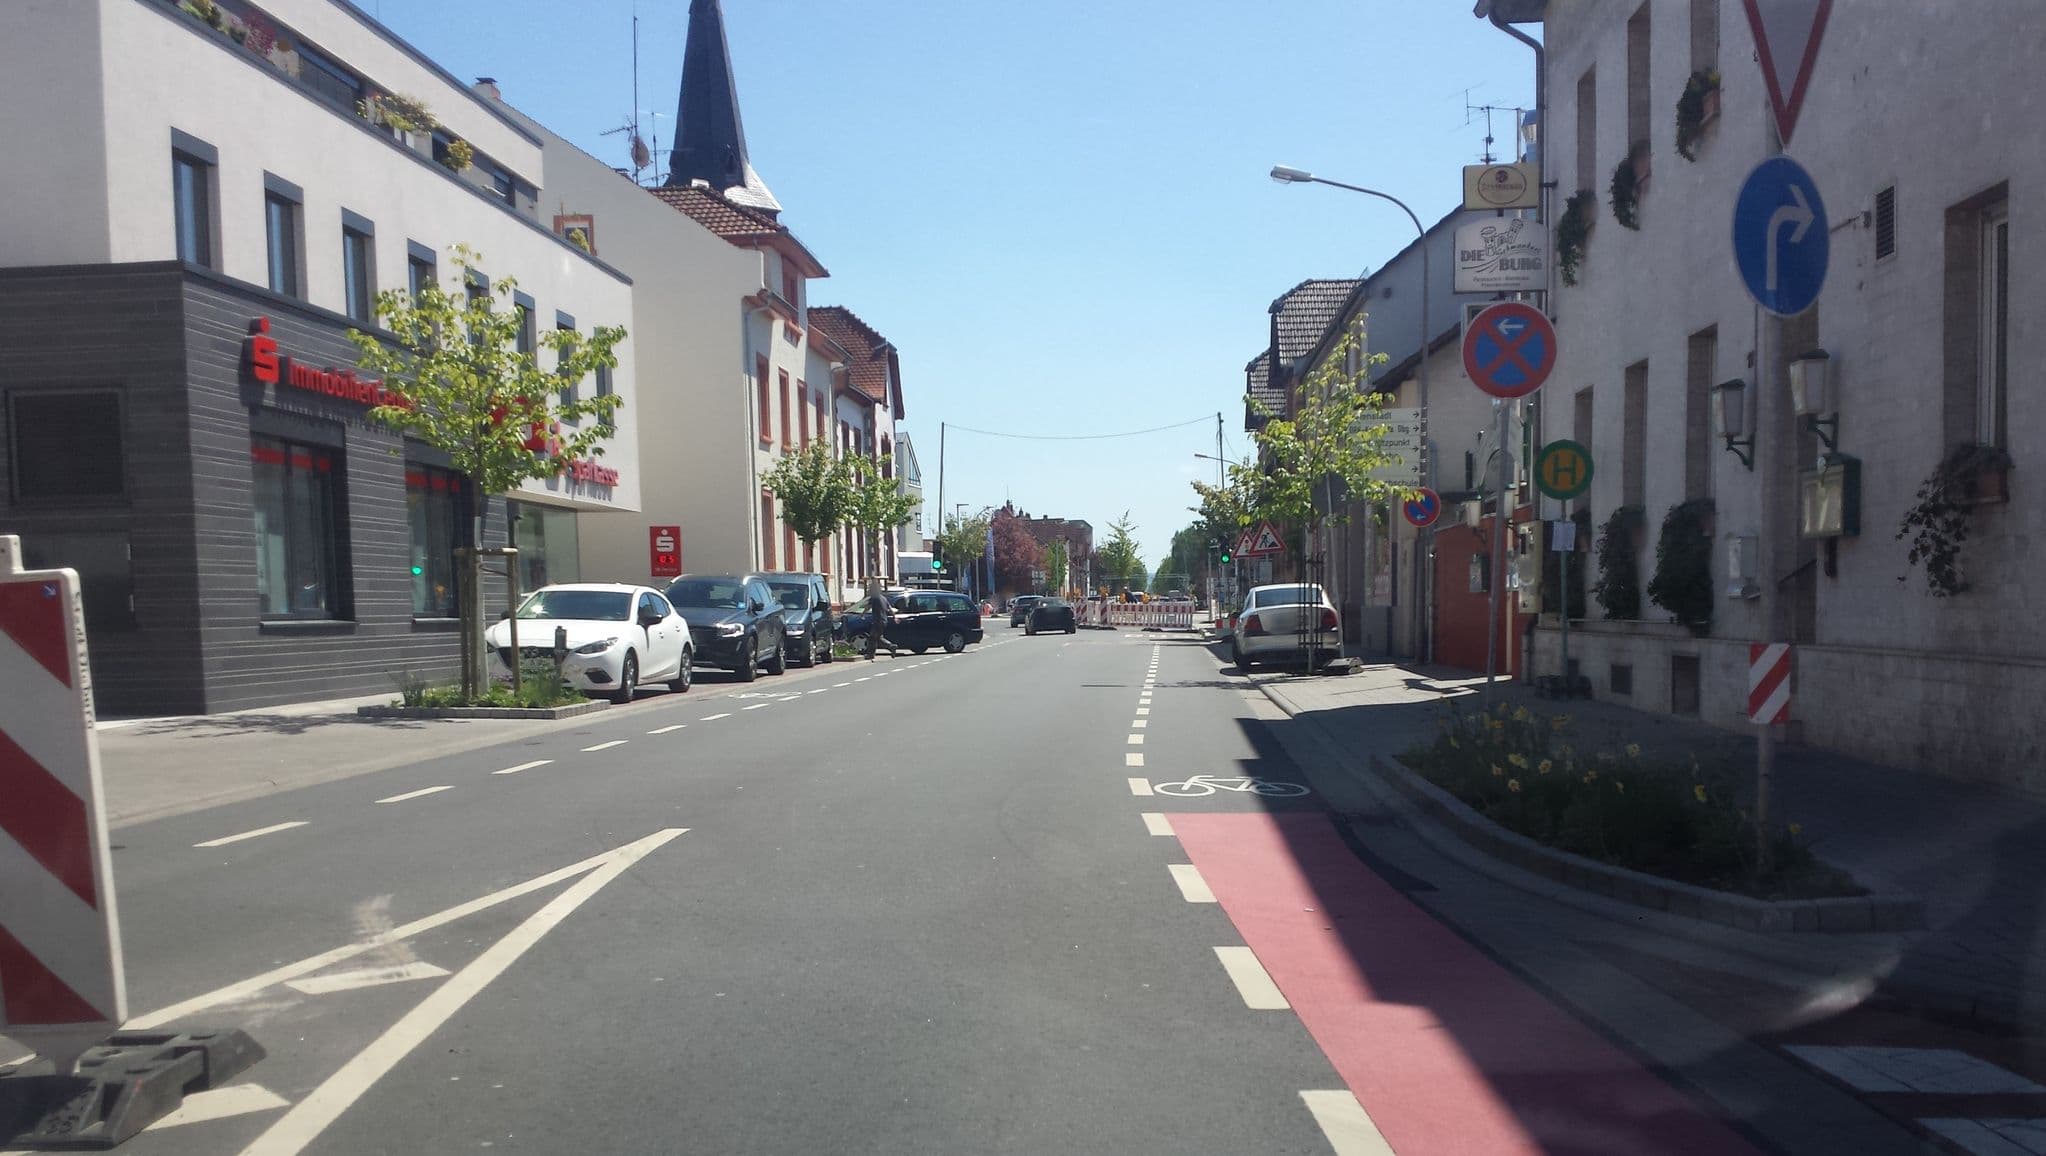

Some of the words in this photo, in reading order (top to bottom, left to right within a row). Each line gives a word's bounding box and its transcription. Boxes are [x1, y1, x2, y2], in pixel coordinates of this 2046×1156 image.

[1460, 250, 1485, 262] DIE
[1499, 257, 1542, 271] BURG
[287, 354, 416, 413] ImmobilienCent
[1552, 453, 1577, 488] H
